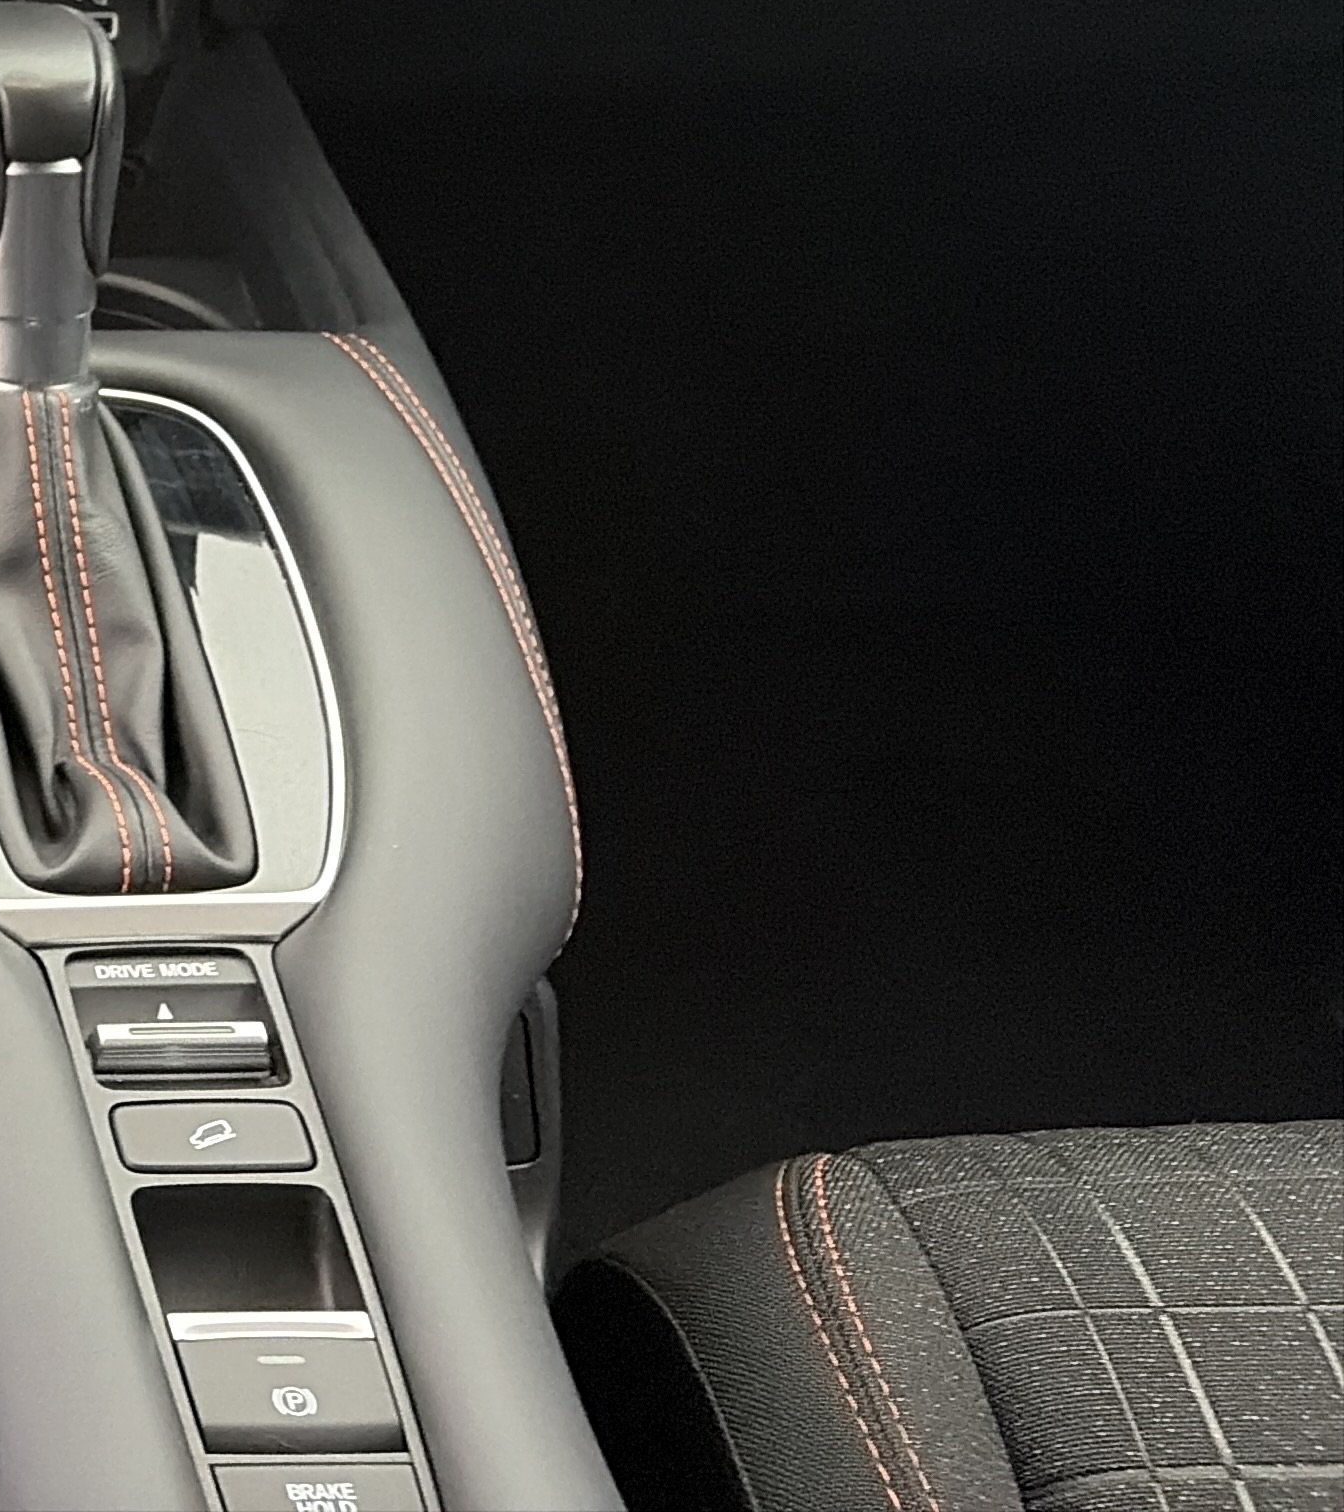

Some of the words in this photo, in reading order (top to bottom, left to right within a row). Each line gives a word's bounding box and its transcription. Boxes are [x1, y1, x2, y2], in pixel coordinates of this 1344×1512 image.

[94, 963, 156, 980] DRIVE
[158, 961, 220, 978] MODE
[285, 1482, 358, 1501] BRAKE
